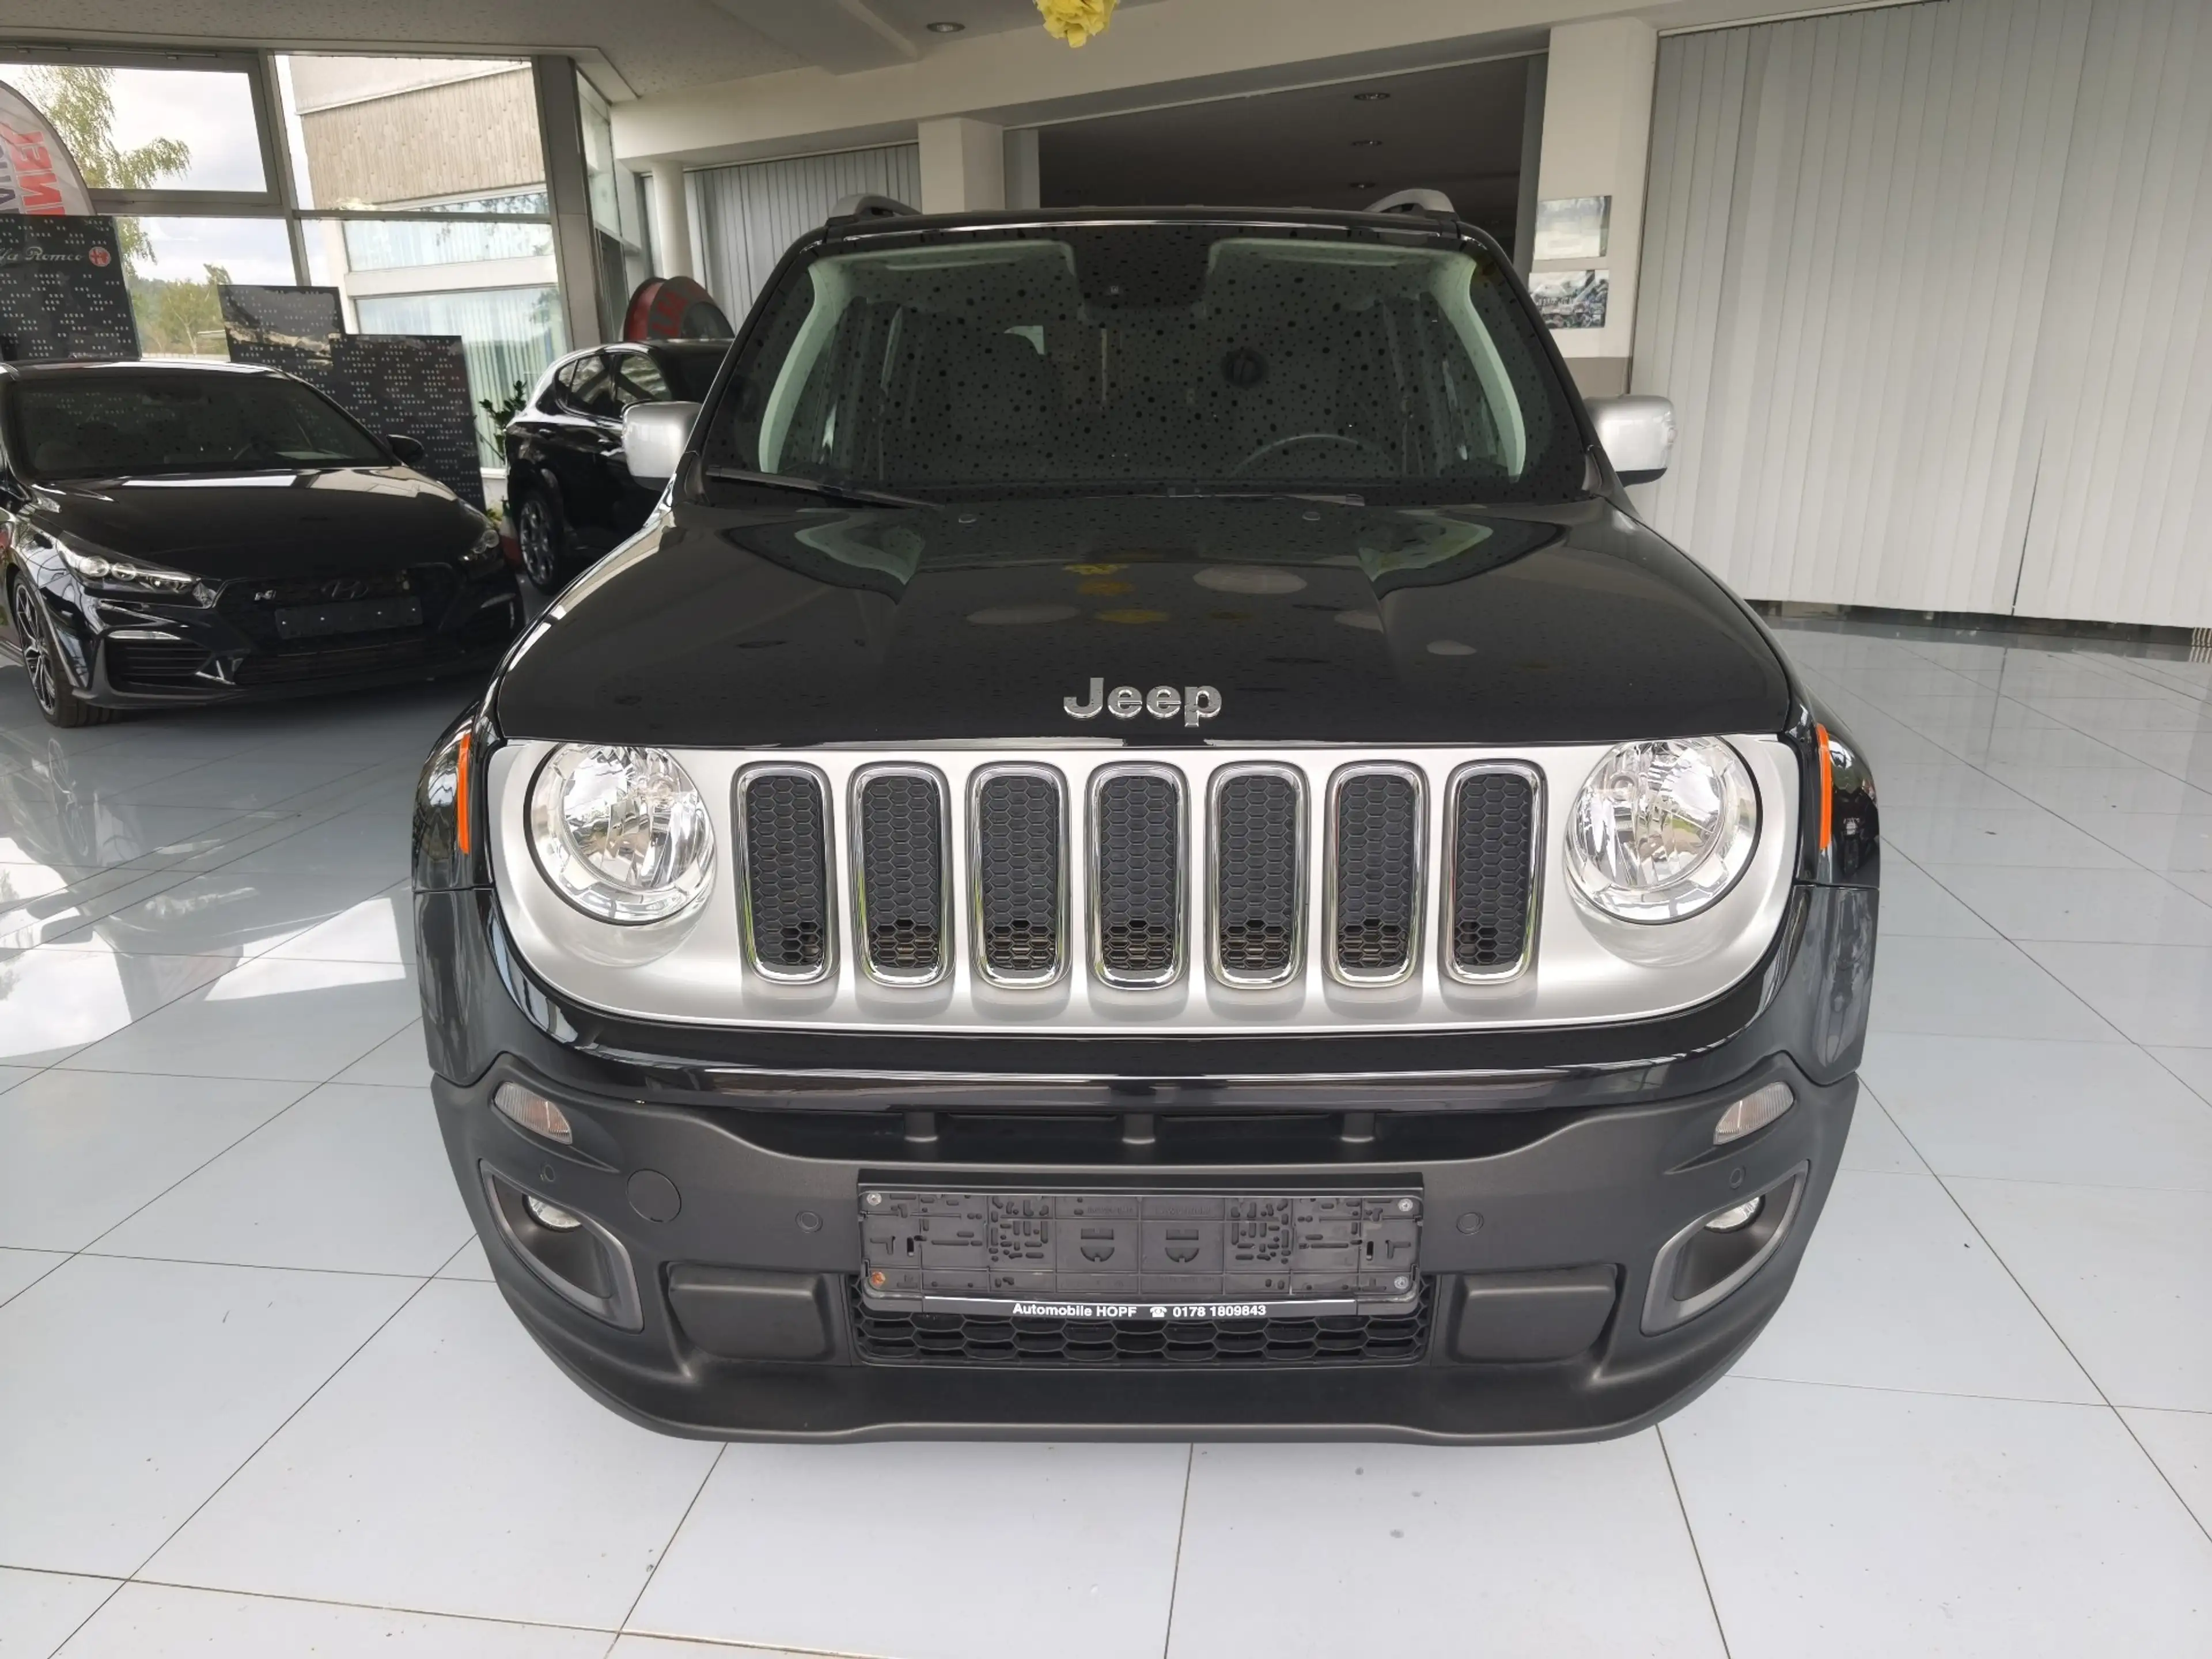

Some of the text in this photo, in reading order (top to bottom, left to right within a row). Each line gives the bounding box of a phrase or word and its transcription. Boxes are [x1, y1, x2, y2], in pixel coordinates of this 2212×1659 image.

[25, 246, 85, 261] Romeo
[1063, 677, 1222, 727] Jeep
[1013, 1303, 1266, 1317] Automobile HOPF 0178 1809843
